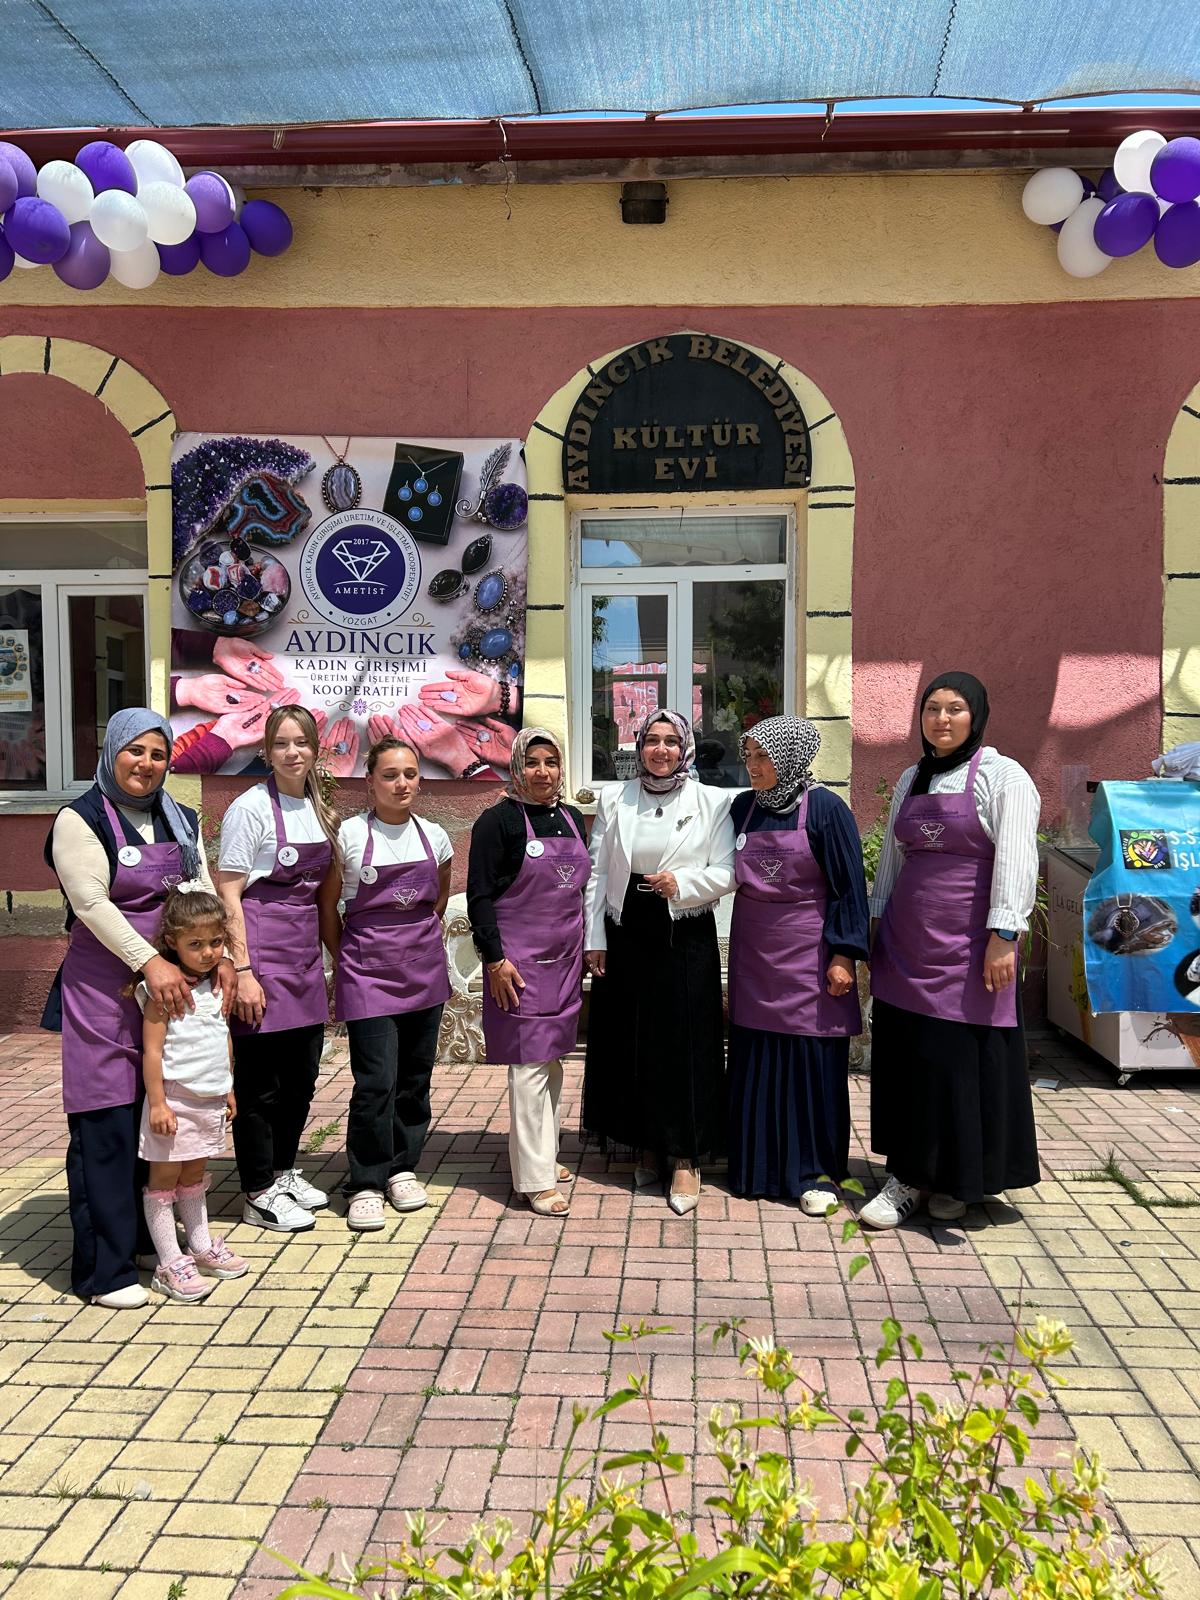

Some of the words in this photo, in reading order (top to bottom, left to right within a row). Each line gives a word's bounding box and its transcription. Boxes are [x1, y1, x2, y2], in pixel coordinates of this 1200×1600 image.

[567, 337, 674, 490] AYDINCIK
[612, 417, 761, 449] KÜLTÜR
[654, 450, 718, 480] EVİ
[376, 517, 387, 527] VE
[353, 538, 370, 546] 2017
[386, 522, 413, 552] İŞLETME
[306, 540, 319, 565] KADIN
[304, 566, 320, 601] AYDINCIK
[334, 586, 386, 595] AMETİST
[342, 615, 378, 626] YOZGAT
[284, 630, 437, 655] AYDINCIK
[295, 659, 347, 671] KADIN
[354, 658, 427, 675] GİRİŞİMİ
[310, 673, 348, 682] ÜRETİM
[351, 675, 364, 683] VE
[368, 674, 411, 684] İŞLETME
[312, 684, 409, 697] KOOPERATİFİ
[1172, 848, 1200, 871] İŞL
